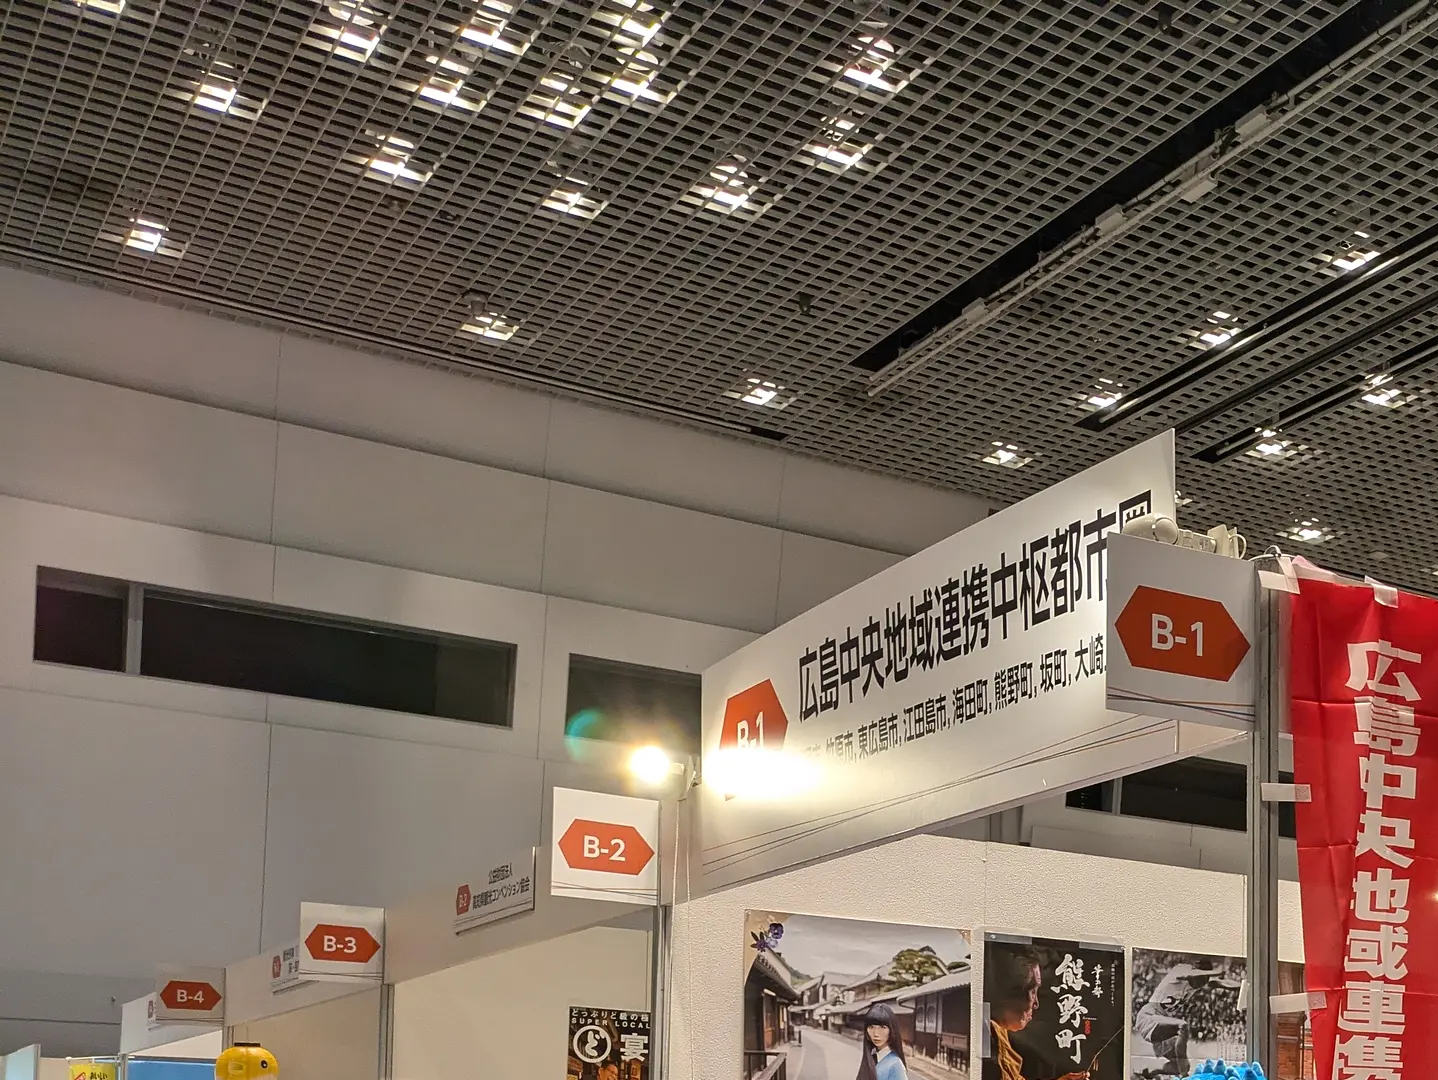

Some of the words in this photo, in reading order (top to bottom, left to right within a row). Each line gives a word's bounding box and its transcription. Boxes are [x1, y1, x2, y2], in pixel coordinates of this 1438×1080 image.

[1151, 614, 1204, 657] B-1
[584, 835, 626, 861] B-2
[323, 935, 357, 954] B-3
[176, 989, 205, 1003] B-4
[1050, 953, 1090, 1064] 熊野町
[571, 1017, 608, 1026] SUPER
[615, 1021, 651, 1029] LOCAL
